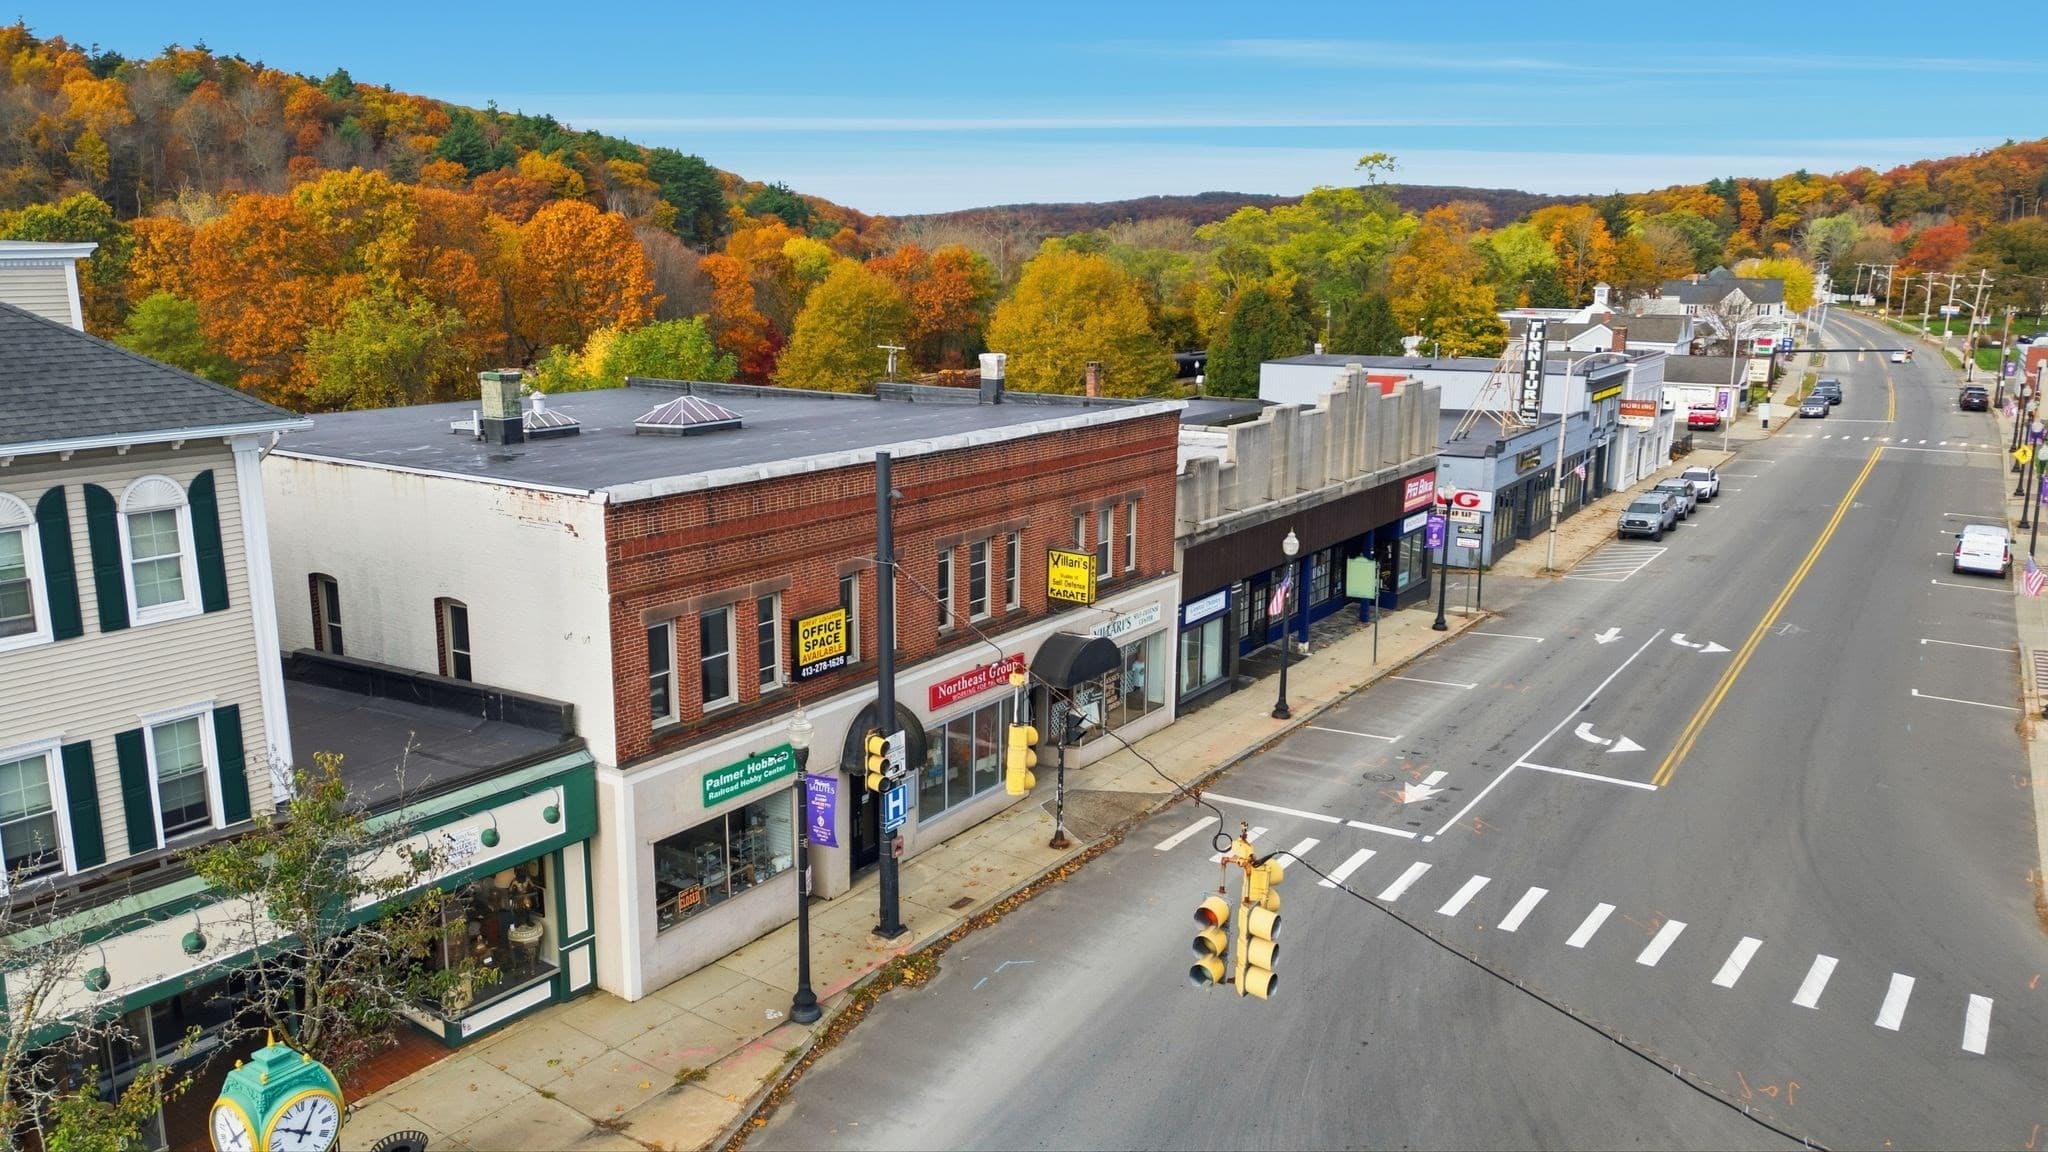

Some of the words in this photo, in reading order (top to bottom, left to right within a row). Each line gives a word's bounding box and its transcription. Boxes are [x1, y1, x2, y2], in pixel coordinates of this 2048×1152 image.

[1523, 321, 1543, 409] FURNITURE
[1050, 552, 1088, 570] Villari's
[1050, 587, 1087, 601] KARATE
[802, 619, 842, 640] OFFICE
[804, 632, 840, 652] SPACE
[802, 643, 844, 663] AVAILABLE
[938, 670, 986, 698] Northeast
[705, 769, 745, 791] Palmer
[708, 783, 740, 800] Railroad
[740, 774, 763, 788] Hobby
[763, 765, 786, 778] Center
[888, 788, 904, 820] H
